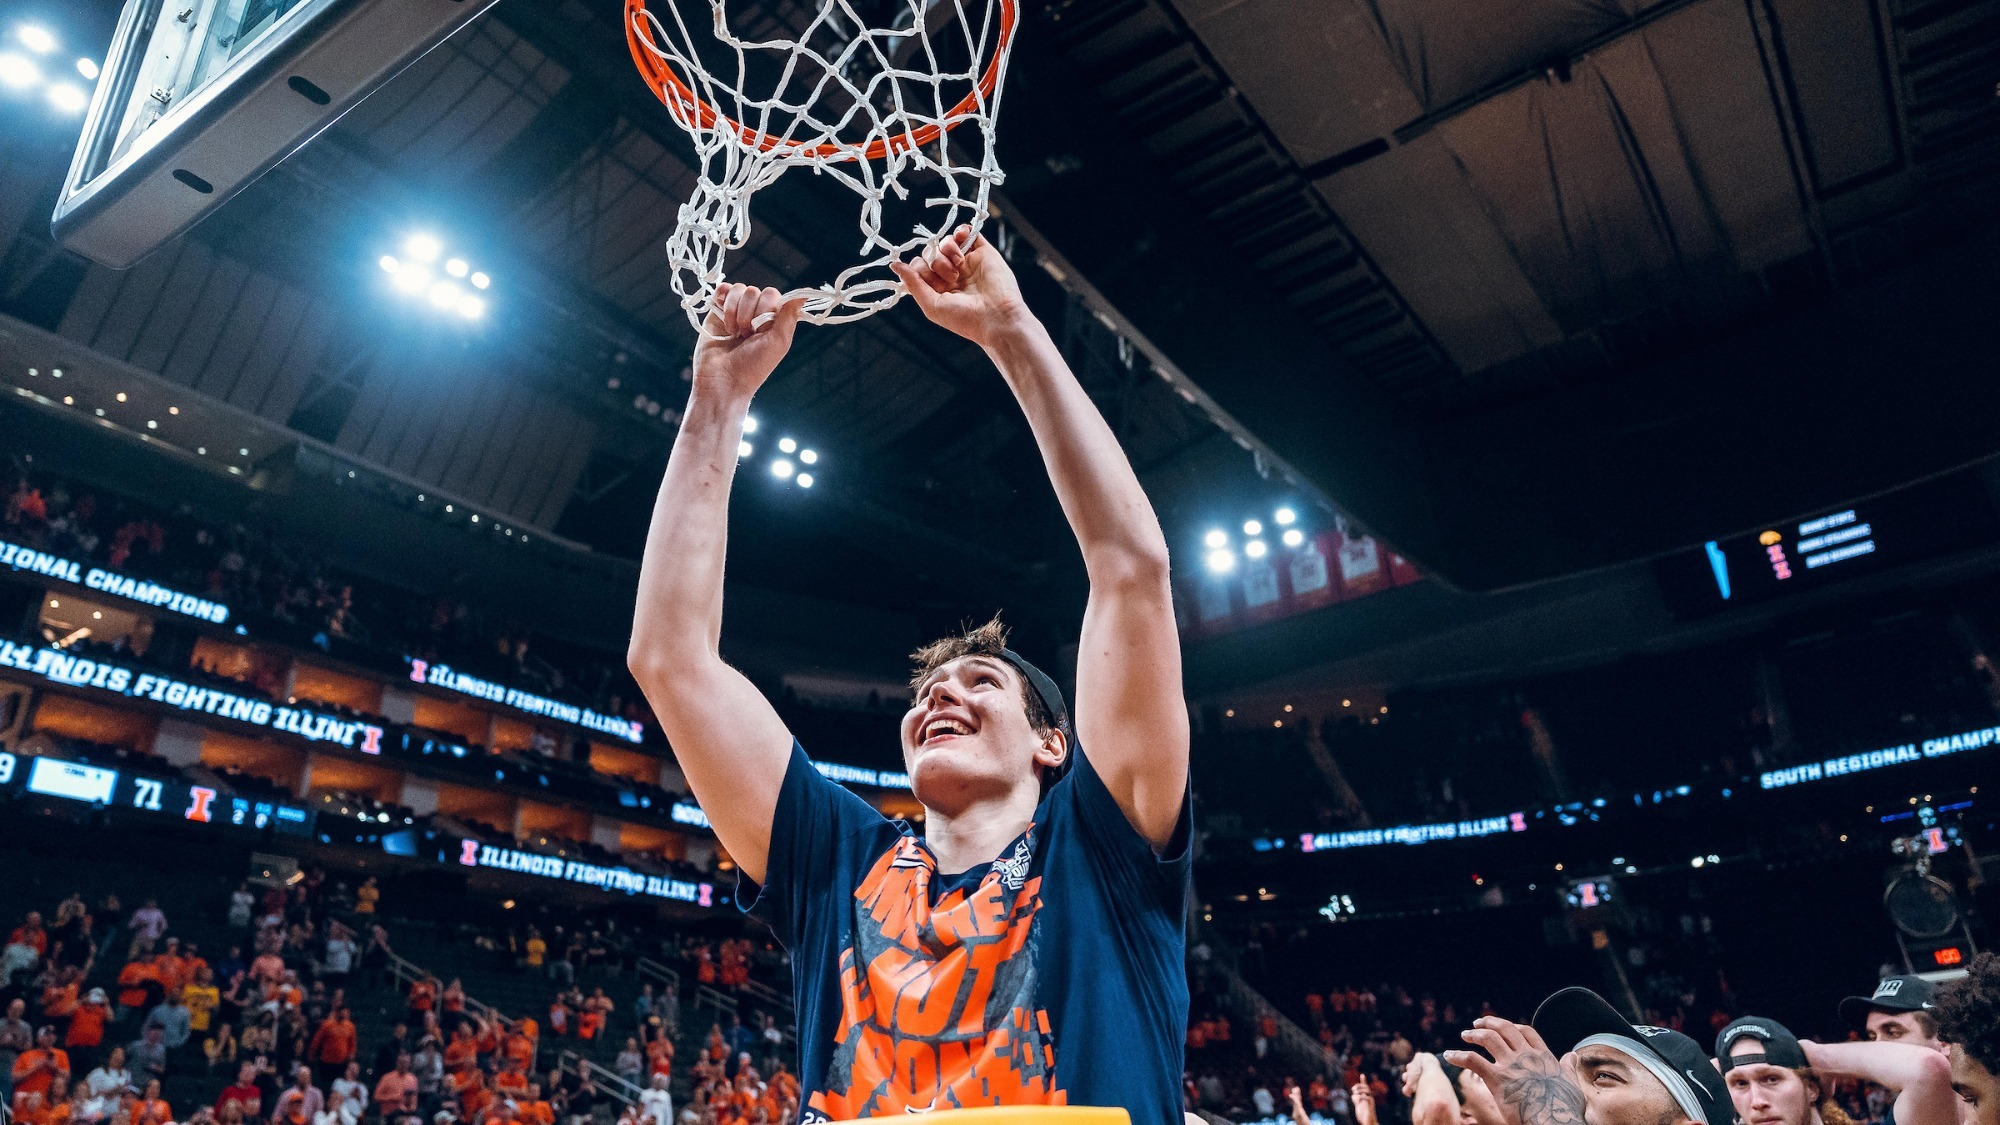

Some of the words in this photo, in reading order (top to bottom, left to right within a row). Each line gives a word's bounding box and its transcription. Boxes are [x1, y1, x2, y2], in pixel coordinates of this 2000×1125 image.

[0, 541, 81, 583] IONAL
[85, 567, 230, 624] CHAMPIONS
[133, 674, 272, 726] FIGHTING
[273, 706, 355, 747] ILLINI
[428, 664, 506, 703] ILLINOIS
[506, 688, 582, 724] FIGHTING
[133, 777, 163, 811] 71
[1760, 762, 1823, 789] SOUTH
[1824, 743, 1920, 778] REGIONAL
[1384, 822, 1458, 846] FIGHTING
[1458, 815, 1509, 837] ILLINI
[479, 845, 565, 878] ILLINOIS
[565, 860, 646, 893] FIGHTING
[645, 875, 698, 902] ILLINI
